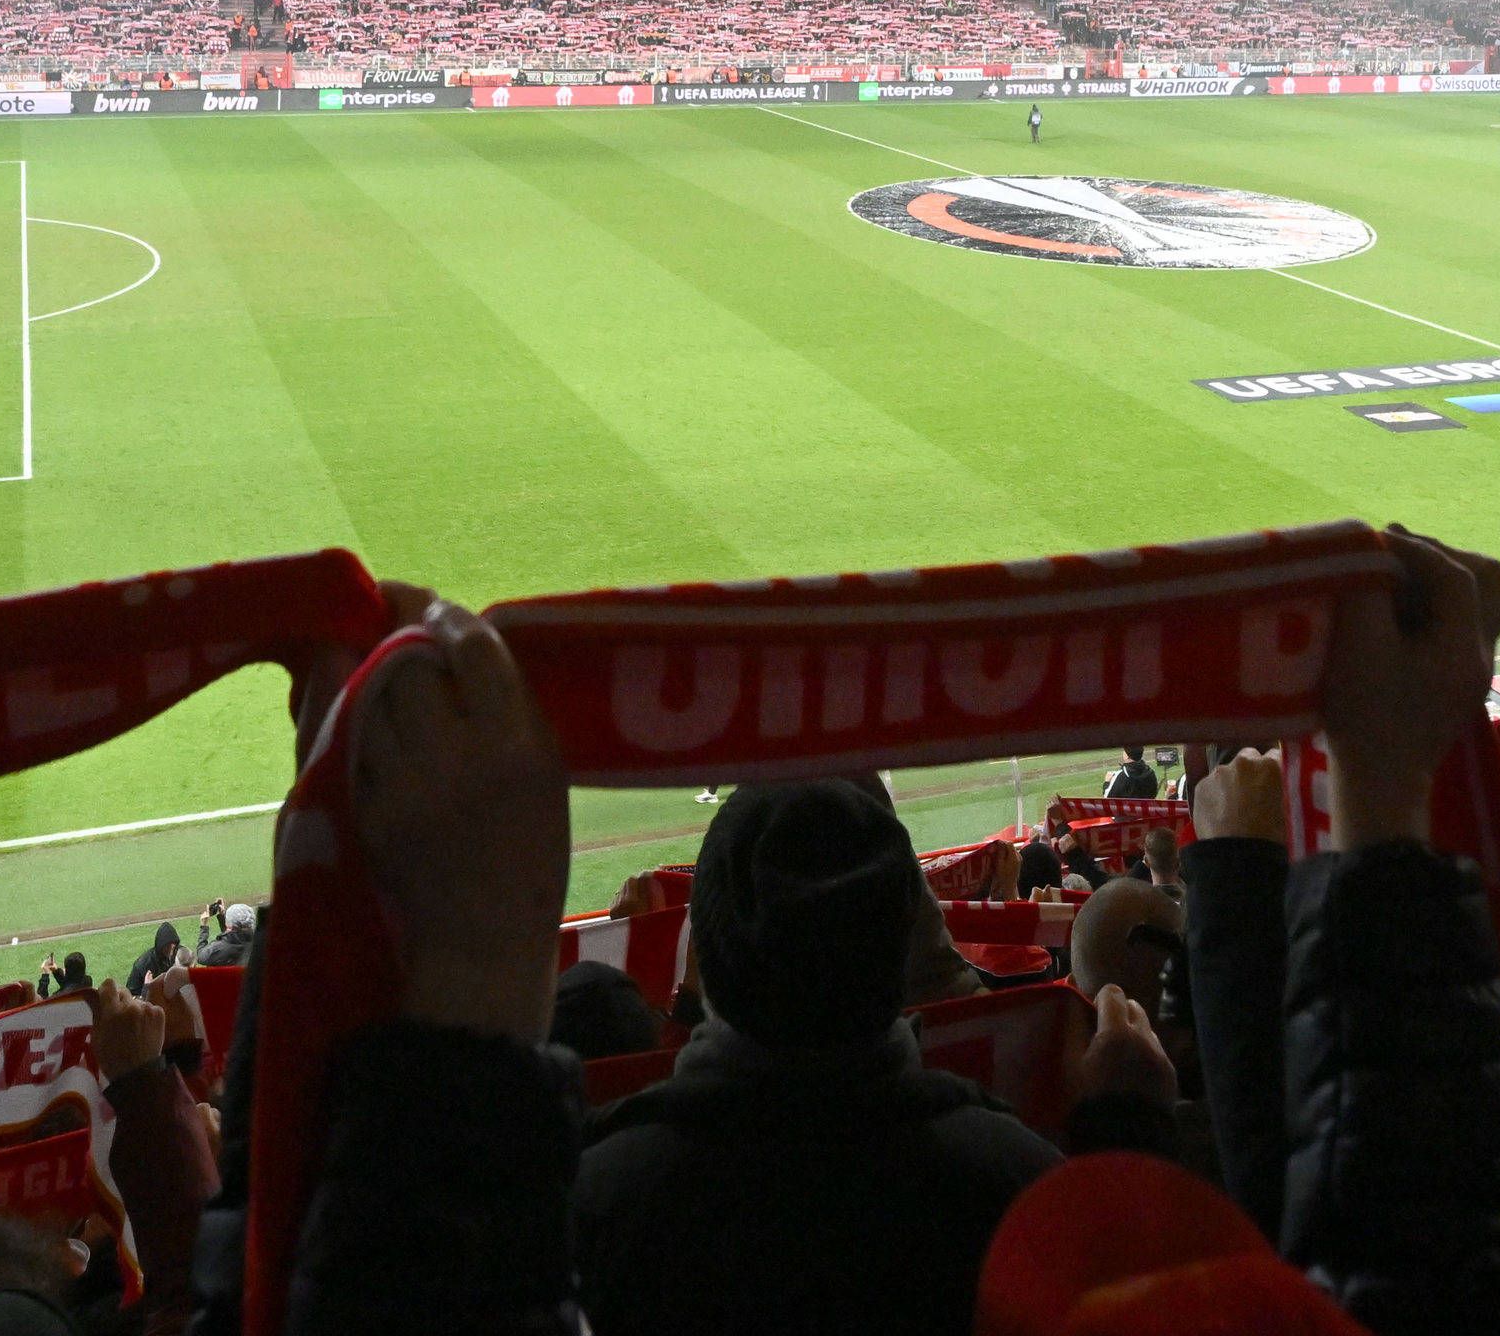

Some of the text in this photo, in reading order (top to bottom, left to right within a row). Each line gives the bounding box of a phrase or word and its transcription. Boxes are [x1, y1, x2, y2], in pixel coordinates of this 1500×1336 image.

[363, 69, 440, 84] FRONTLINE
[674, 86, 807, 100] UEFA EUROPA LEAGUE
[1006, 82, 1126, 96] STRAUSS STRAUSS
[94, 91, 150, 113] bwin
[203, 90, 258, 112] bwin
[1208, 368, 1394, 401] UEFA
